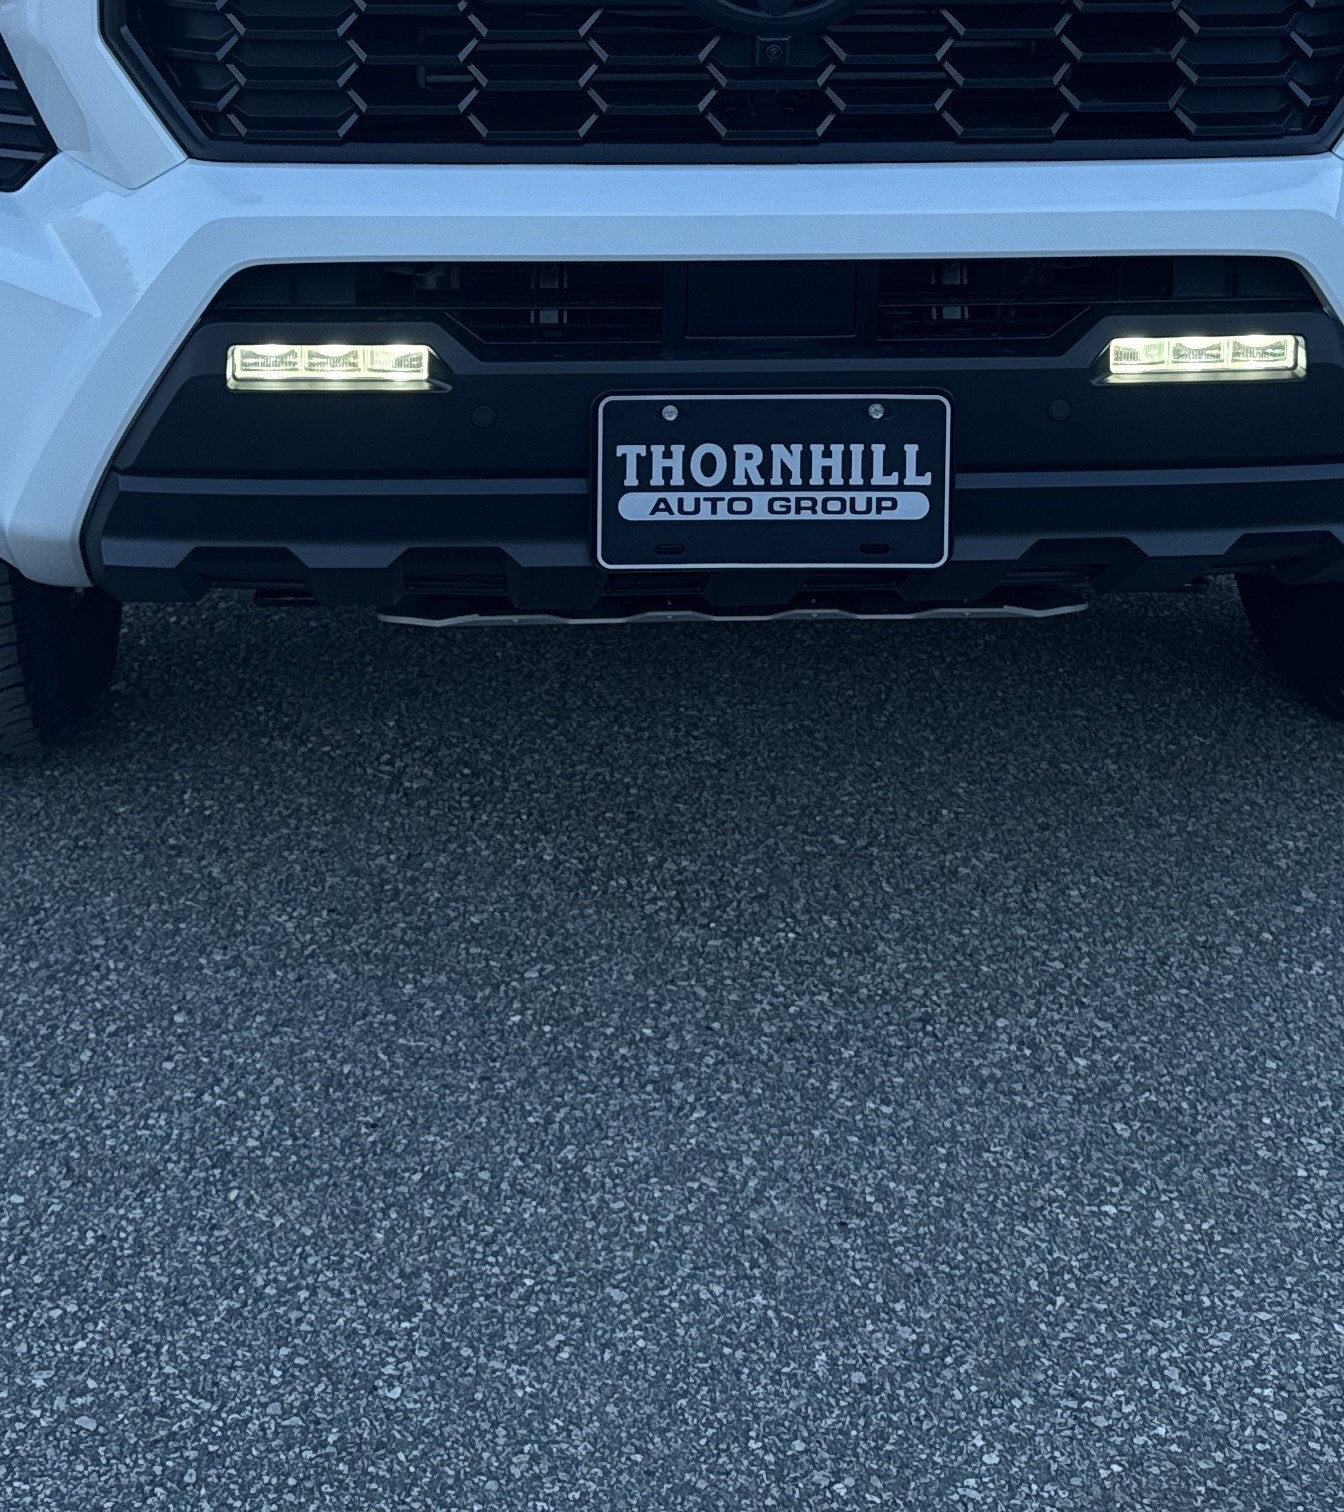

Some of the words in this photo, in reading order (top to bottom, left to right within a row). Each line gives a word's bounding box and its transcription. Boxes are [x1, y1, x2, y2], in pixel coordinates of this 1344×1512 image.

[616, 443, 932, 487] THORNHILL
[649, 496, 754, 516] AUTO
[767, 496, 899, 516] GROUP
